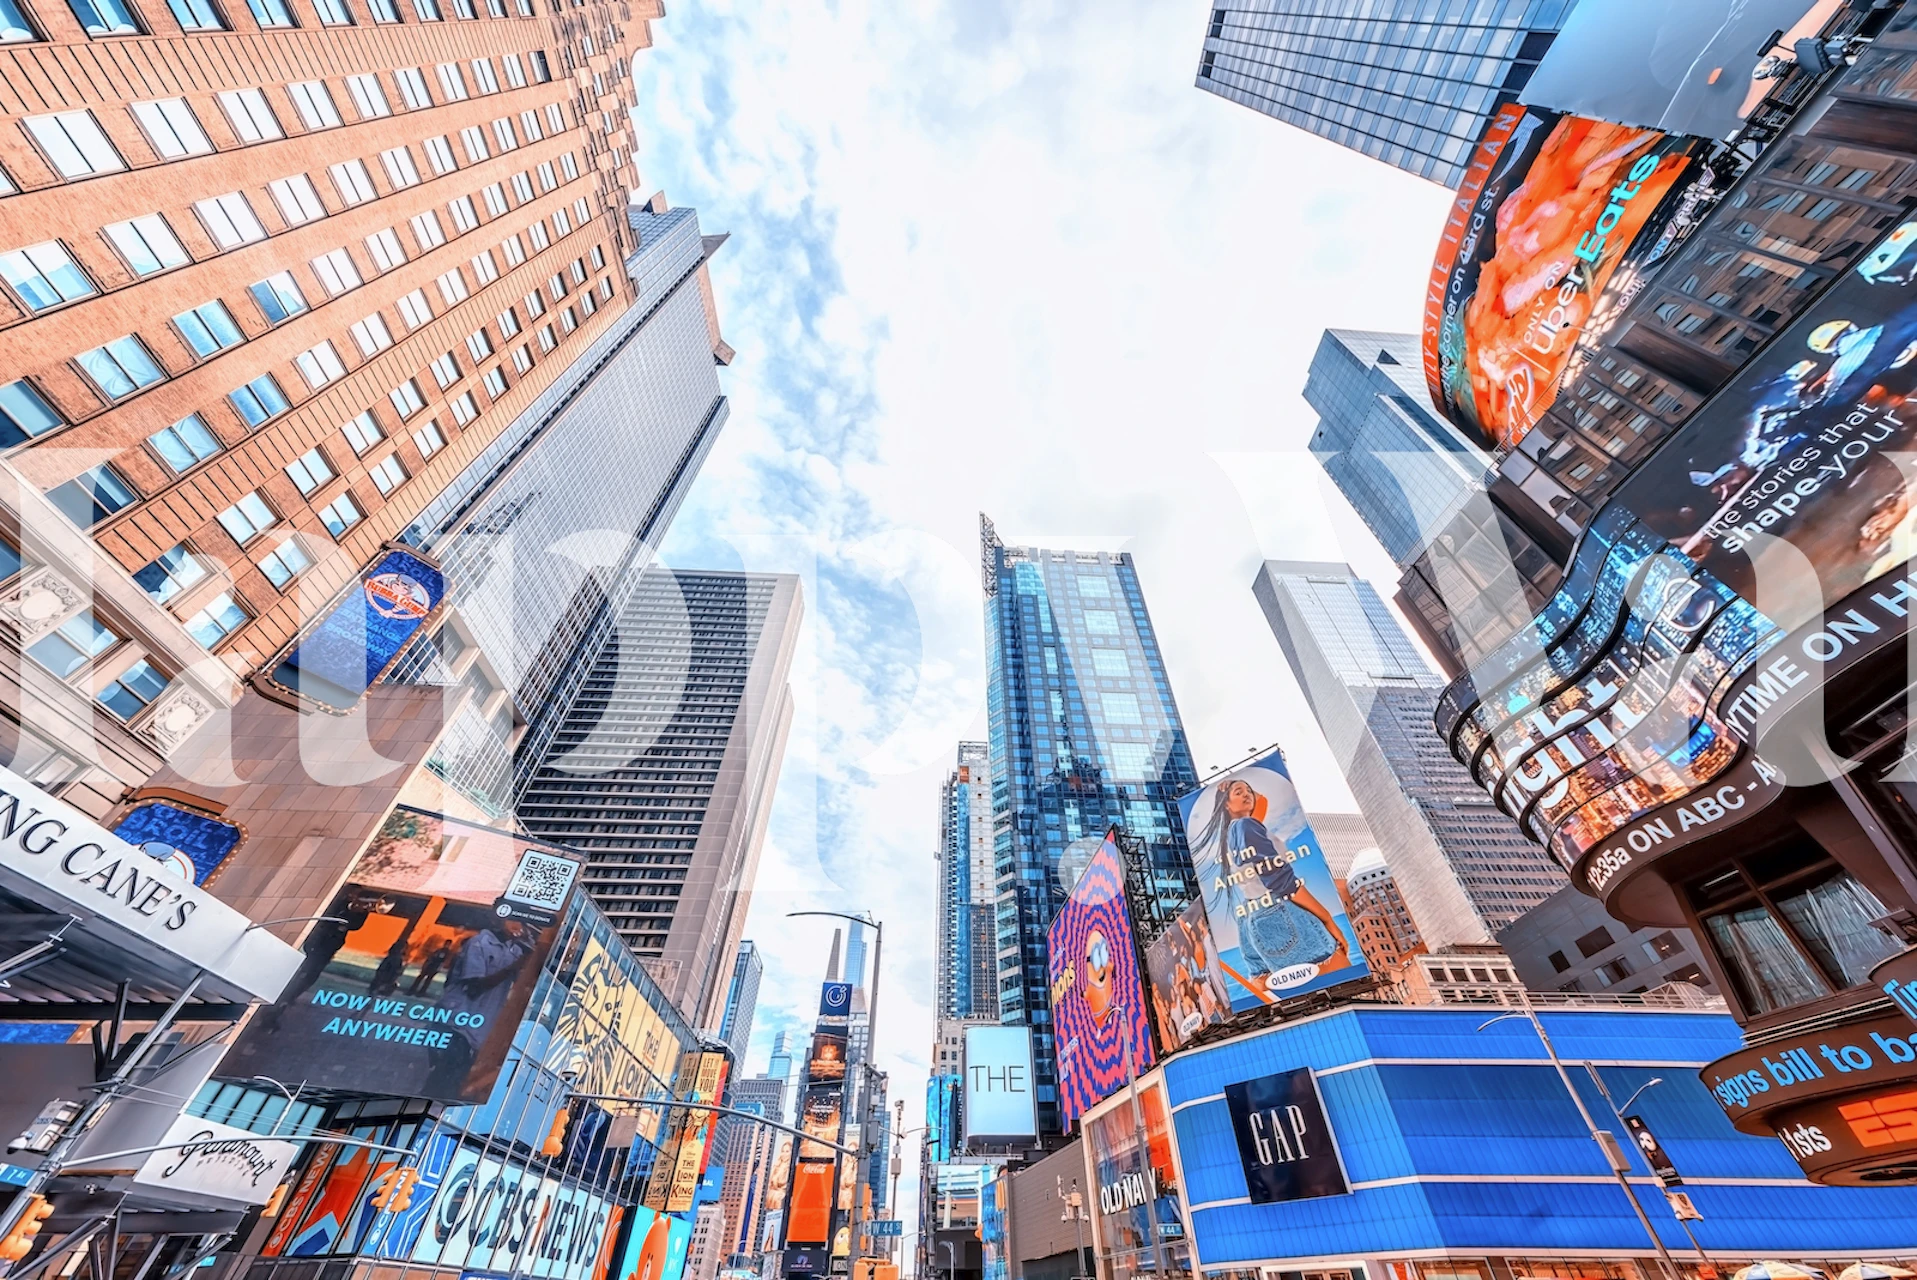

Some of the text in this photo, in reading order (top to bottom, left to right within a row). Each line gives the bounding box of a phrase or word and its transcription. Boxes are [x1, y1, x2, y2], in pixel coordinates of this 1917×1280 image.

[1574, 154, 1660, 263] Eats
[1532, 265, 1584, 355] Uber
[1742, 446, 1822, 510] stories
[1819, 402, 1879, 446] that
[1722, 409, 1904, 554] shape your
[366, 579, 429, 617] BUBBA GUMP
[1627, 817, 1675, 854] ON
[1675, 785, 1746, 832] ABC
[1801, 608, 1881, 663] ON
[61, 842, 198, 931] CANE'S
[1213, 843, 1313, 892] American
[1271, 966, 1314, 987] OLD NAVY
[312, 989, 486, 1030] NOW WE CAN GO
[321, 1016, 454, 1051] ANYWHERE
[969, 1065, 1026, 1093] THE
[1760, 1046, 1826, 1087] bill
[1819, 1043, 1874, 1074] to
[1249, 1105, 1310, 1166] GAP
[161, 1130, 277, 1188] Paramount
[676, 1170, 695, 1183] LION
[682, 1159, 695, 1168] THE
[279, 1140, 334, 1233] CBS NEWS
[670, 1183, 693, 1200] KING
[1100, 1181, 1123, 1215] OLD
[527, 1194, 605, 1269] NEWS
[882, 1222, 894, 1234] 44
[1166, 1225, 1176, 1235] 44
